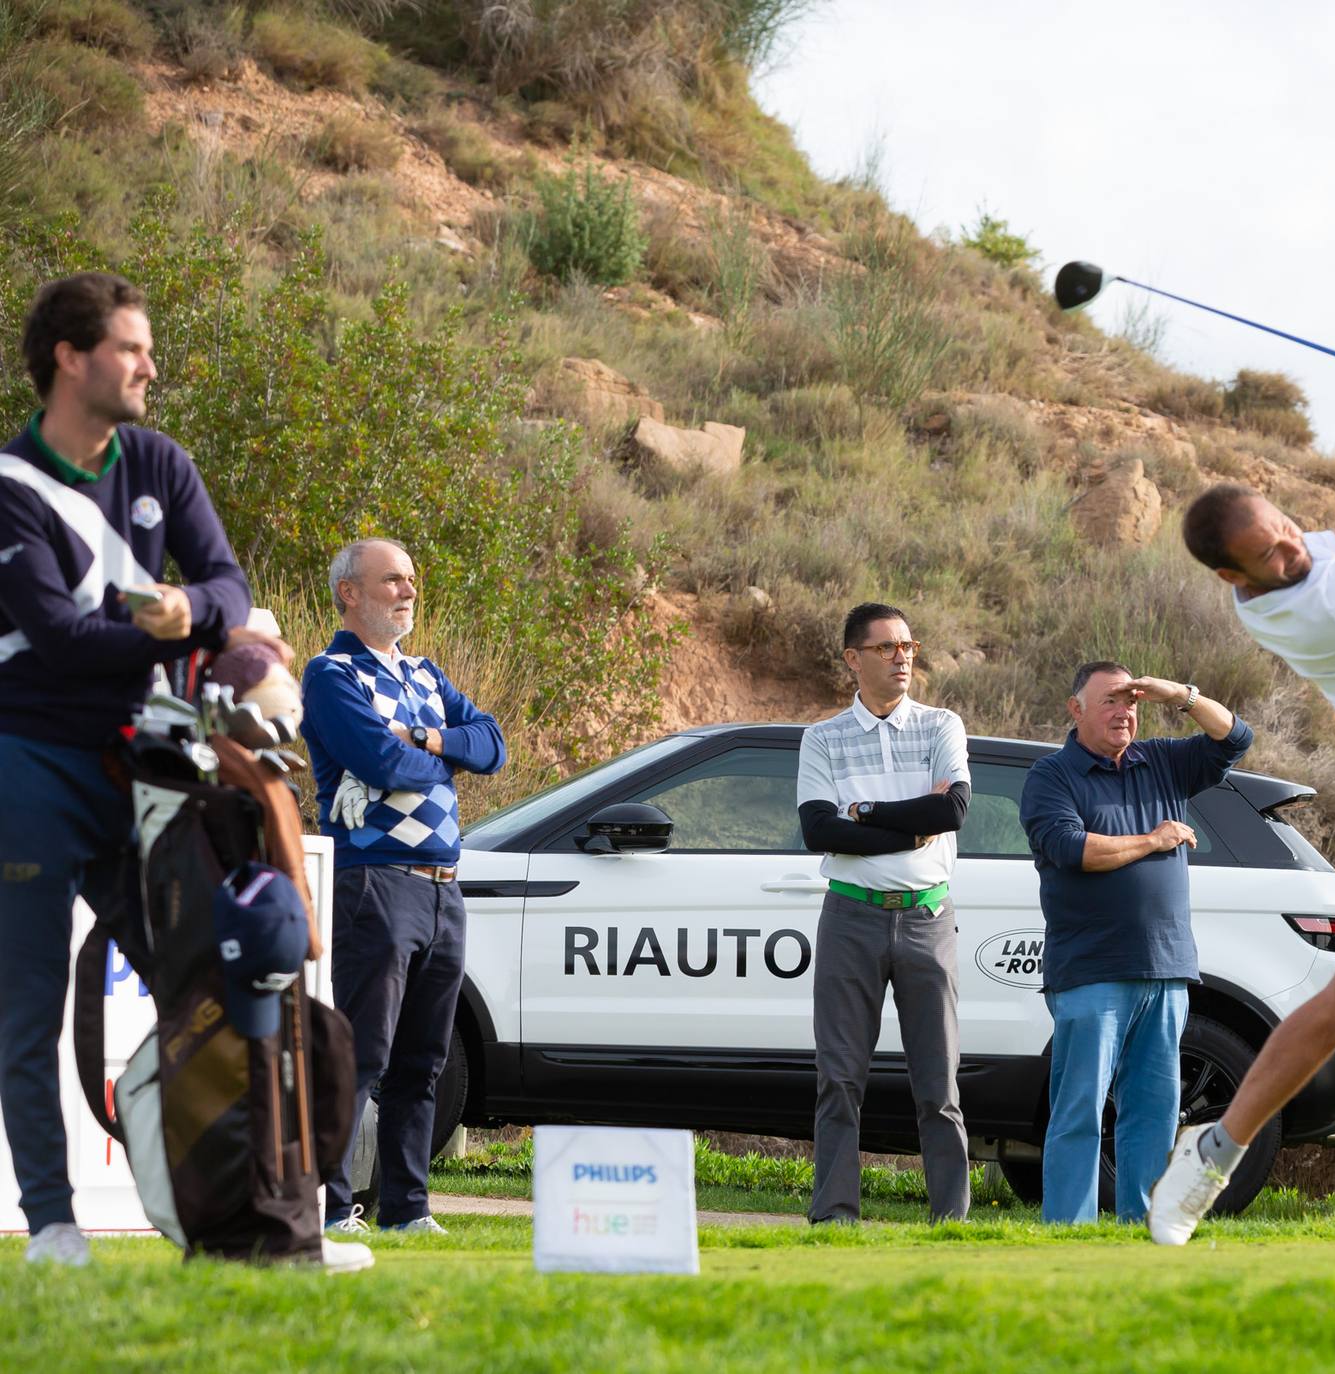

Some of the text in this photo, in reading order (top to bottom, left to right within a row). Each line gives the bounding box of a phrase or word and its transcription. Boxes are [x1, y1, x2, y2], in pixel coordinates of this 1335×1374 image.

[564, 926, 812, 979] RIAUTO
[573, 1163, 657, 1184] PHILIPS
[573, 1206, 629, 1235] hue
